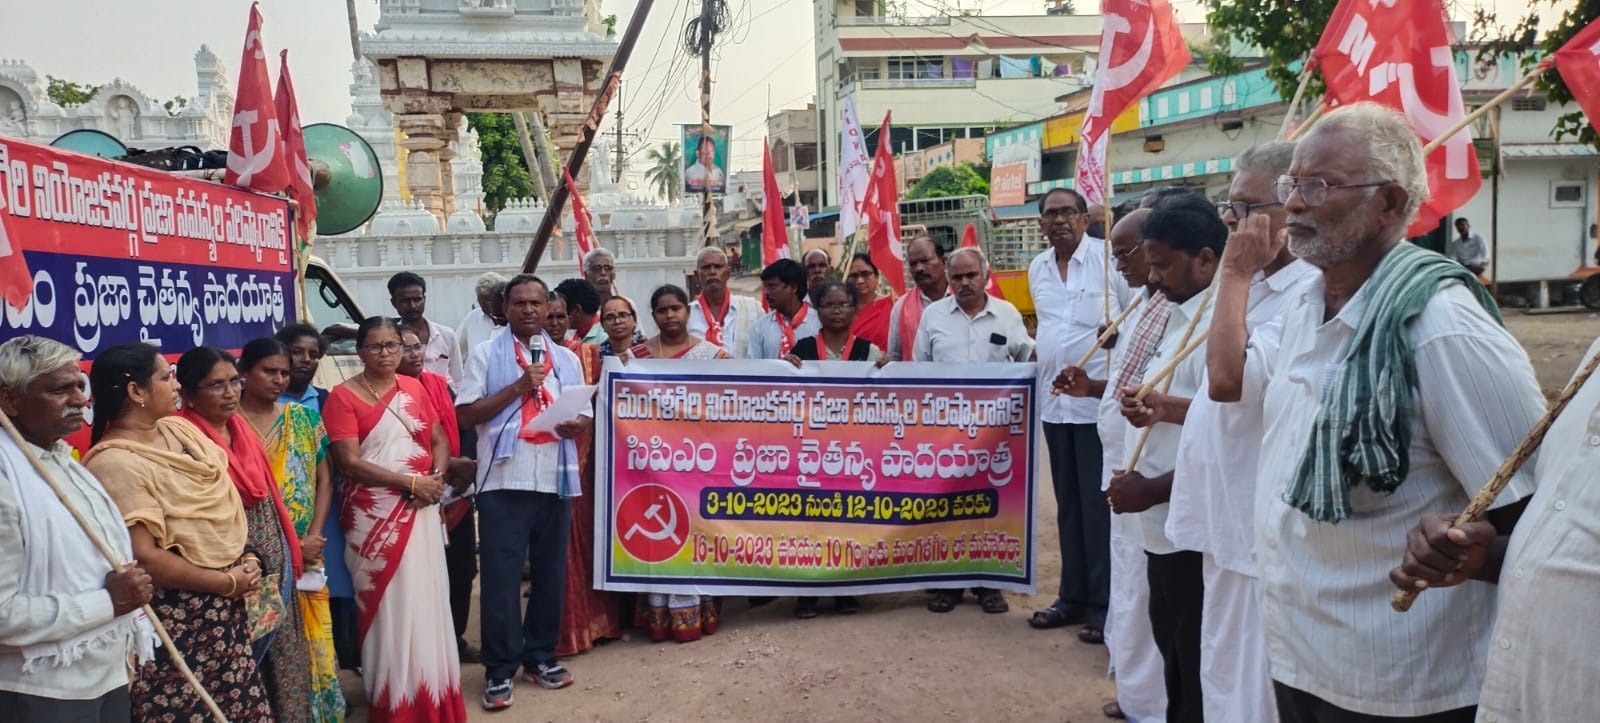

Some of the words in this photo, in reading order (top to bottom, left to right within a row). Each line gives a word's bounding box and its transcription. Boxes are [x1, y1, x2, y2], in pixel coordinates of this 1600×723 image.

[33, 160, 140, 257] నియోజకవర్గ
[138, 181, 175, 243] ప్రజా
[175, 187, 225, 262] సమస్యల
[74, 262, 131, 352] ప్రజా
[137, 265, 204, 347] చైతన్య
[203, 272, 286, 335] పాదయాత్ర
[617, 386, 701, 420] మంగళగిరి
[705, 389, 806, 438] నియోజకవర్గ
[809, 391, 849, 429] ప్రజా
[853, 392, 918, 438] సమస్యల
[921, 392, 1024, 438] పరిష్కారానికై
[626, 434, 717, 473] సిపిఎం
[730, 438, 790, 486] ప్రజా
[797, 439, 877, 491] చైతన్య
[881, 441, 1013, 486] పాదయాత్ర
[707, 491, 801, 516] 3-10-2023
[805, 492, 843, 517] నుండి
[846, 495, 949, 520] 12-10-2023
[952, 493, 992, 516] వరకు
[692, 533, 774, 566] 16-10-2023
[778, 534, 823, 567] ఉదయం
[825, 537, 842, 568] 10
[892, 532, 949, 566] మంగళగిరి
